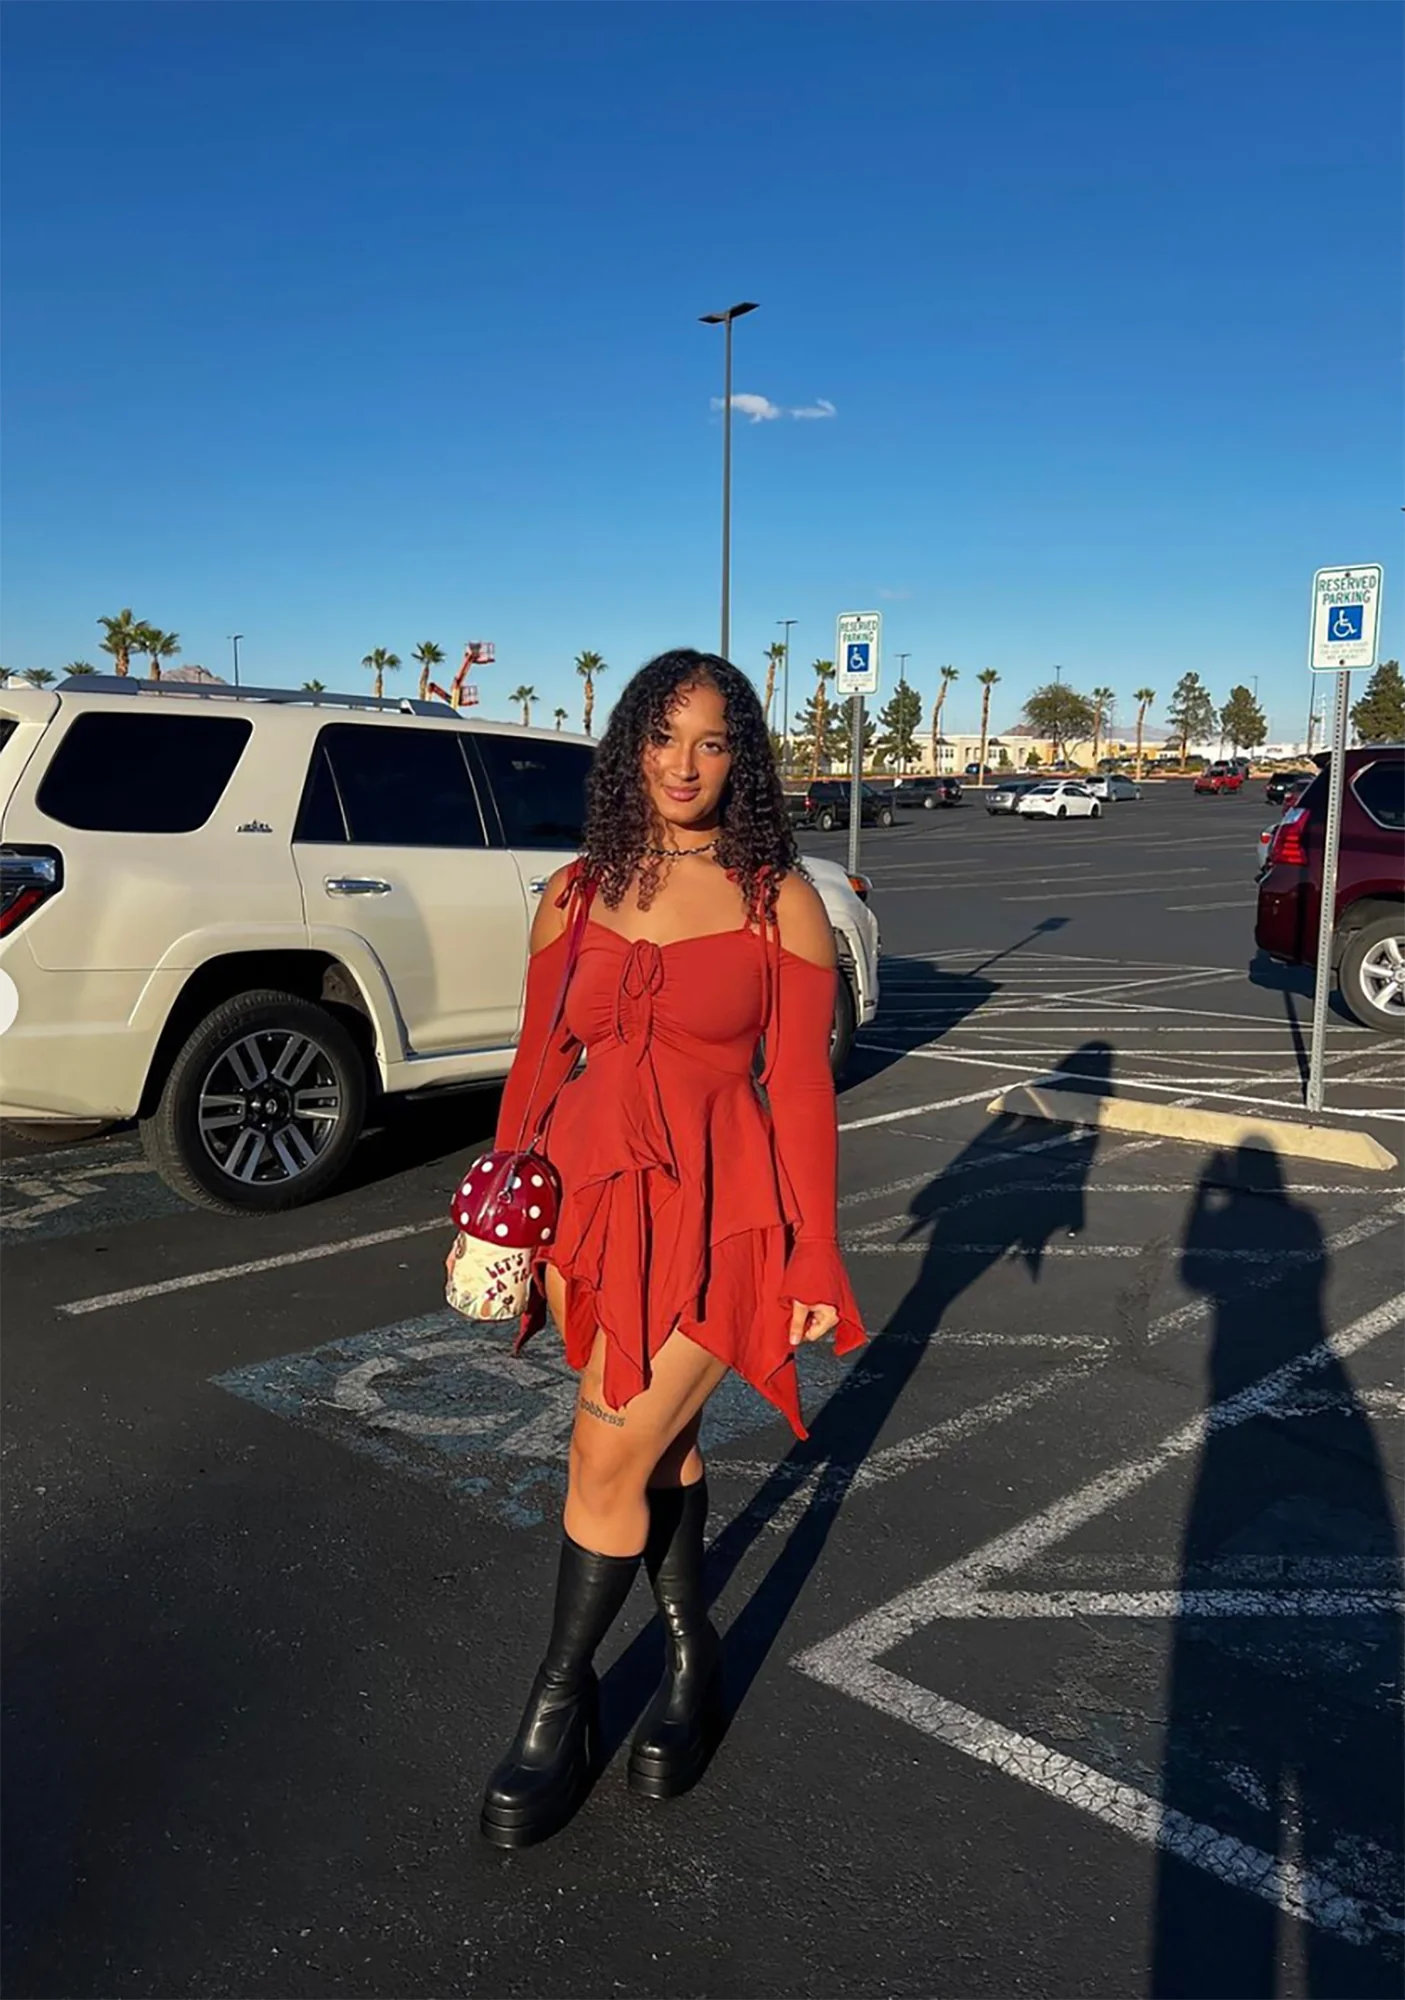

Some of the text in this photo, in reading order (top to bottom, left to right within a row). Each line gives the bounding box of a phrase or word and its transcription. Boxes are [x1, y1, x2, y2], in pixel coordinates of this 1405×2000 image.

[1318, 575, 1377, 592] RESERVED
[1322, 589, 1371, 605] PARKING
[840, 620, 877, 632] RESERVED
[843, 631, 874, 643] PARKING
[485, 1252, 524, 1279] LET'S
